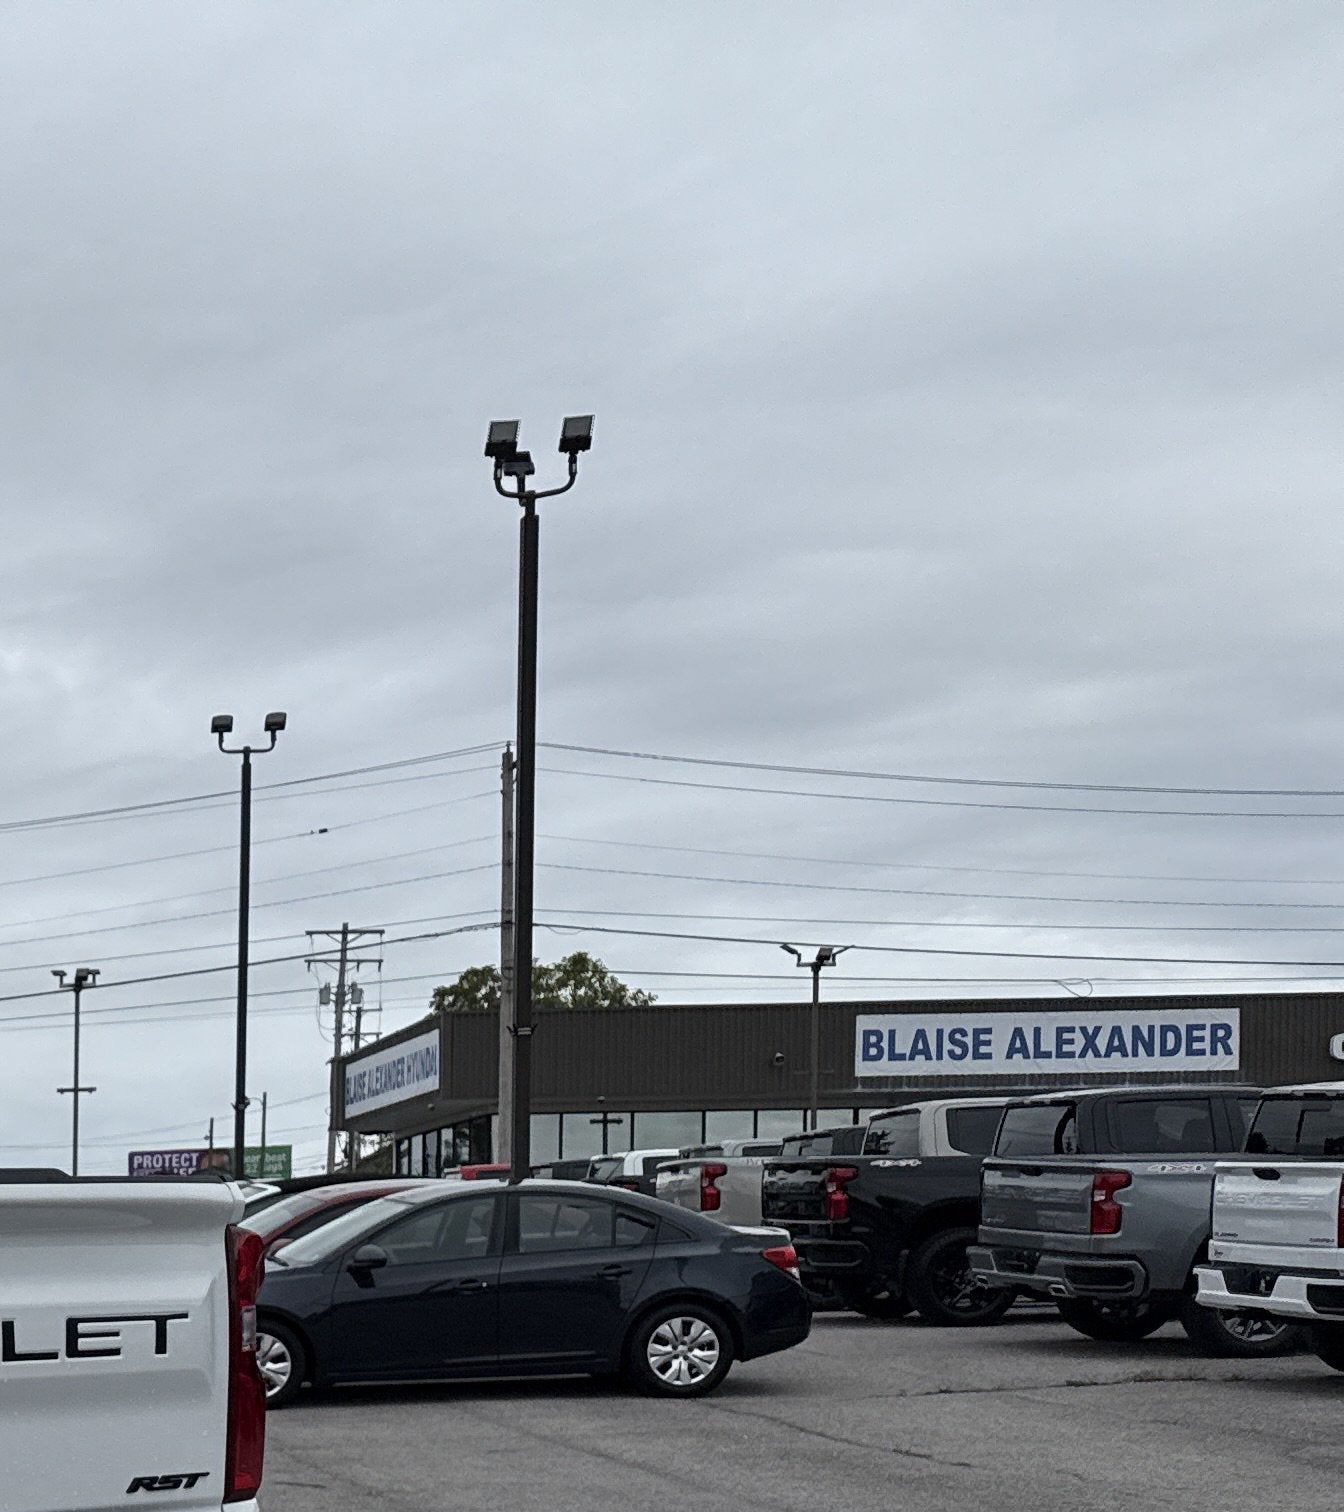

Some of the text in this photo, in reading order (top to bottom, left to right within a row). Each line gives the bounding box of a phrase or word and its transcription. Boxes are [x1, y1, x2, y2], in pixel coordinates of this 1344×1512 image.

[861, 1022, 1234, 1062] BLAISE ALEXANDER
[133, 1153, 199, 1169] PROTECT
[126, 1472, 210, 1494] RST
